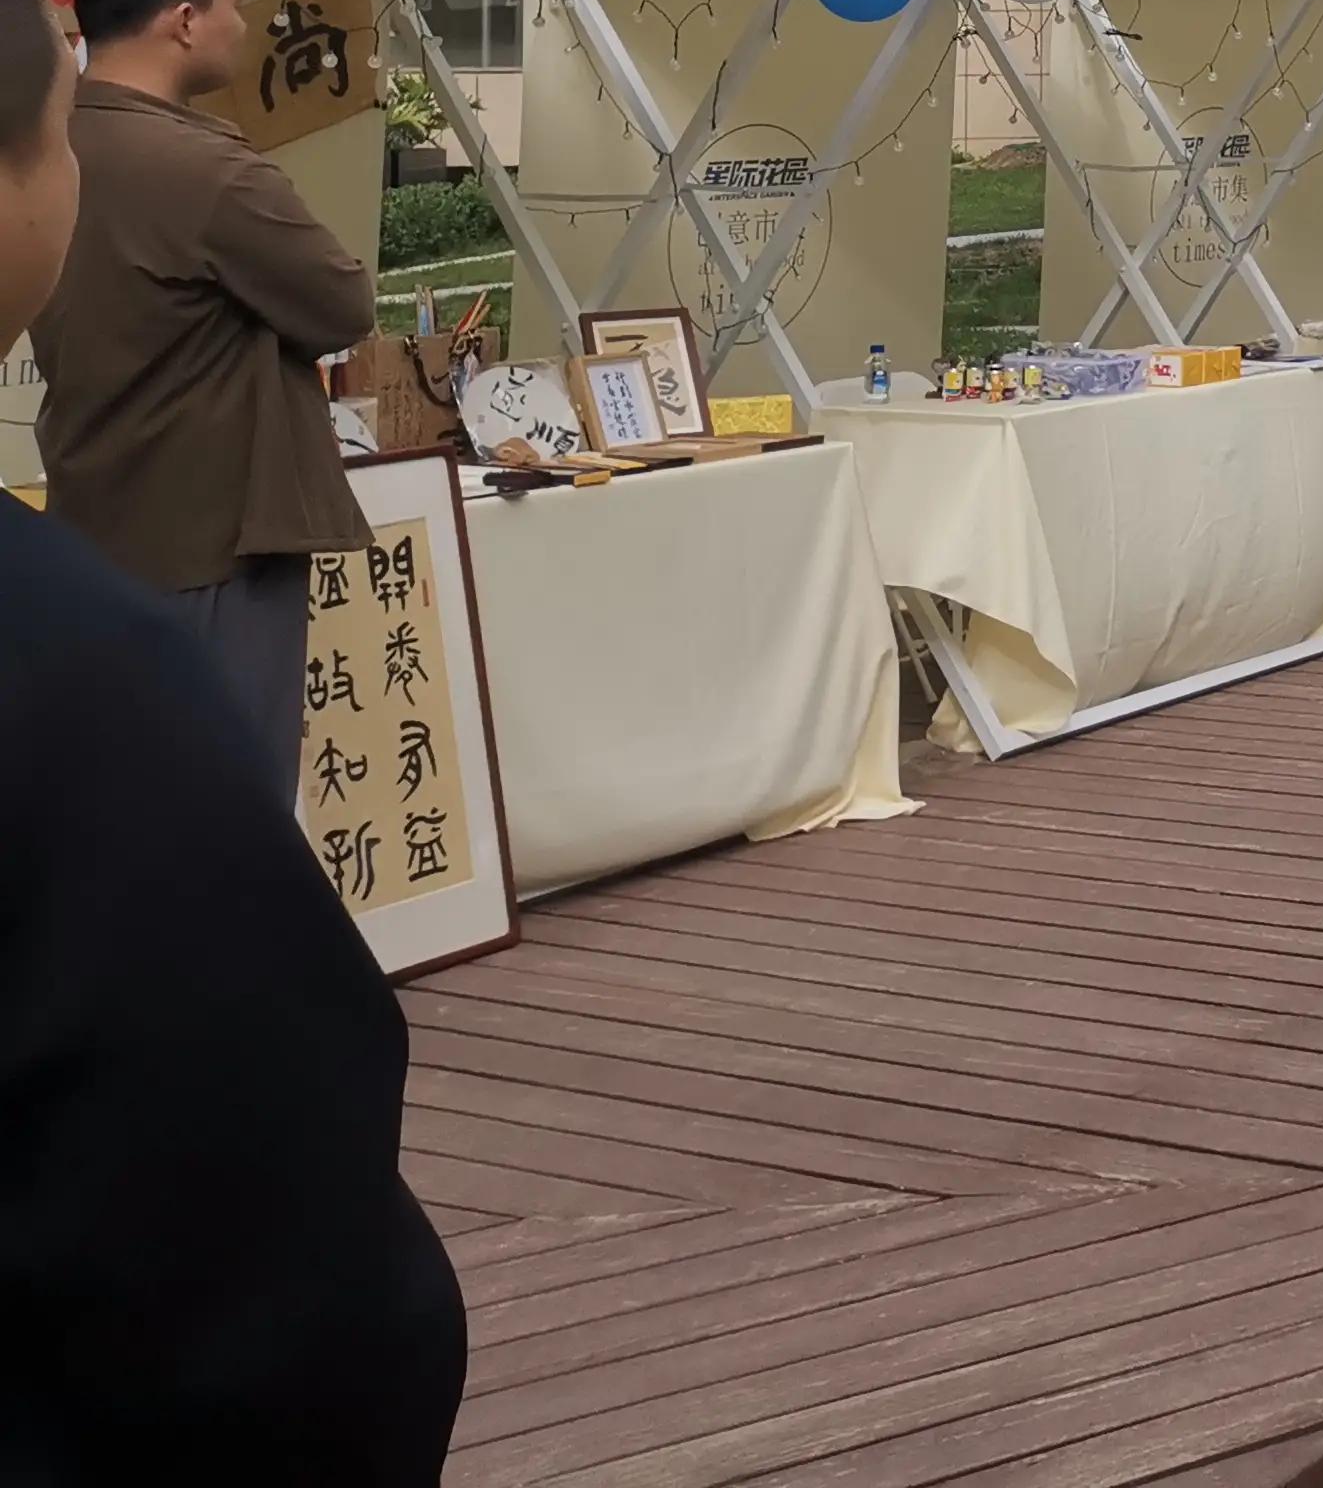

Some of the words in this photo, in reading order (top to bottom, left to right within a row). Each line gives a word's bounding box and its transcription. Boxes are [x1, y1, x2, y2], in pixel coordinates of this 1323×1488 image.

[260, 0, 349, 112] 尚
[703, 158, 809, 187] 星际花园
[1173, 237, 1226, 264] times
